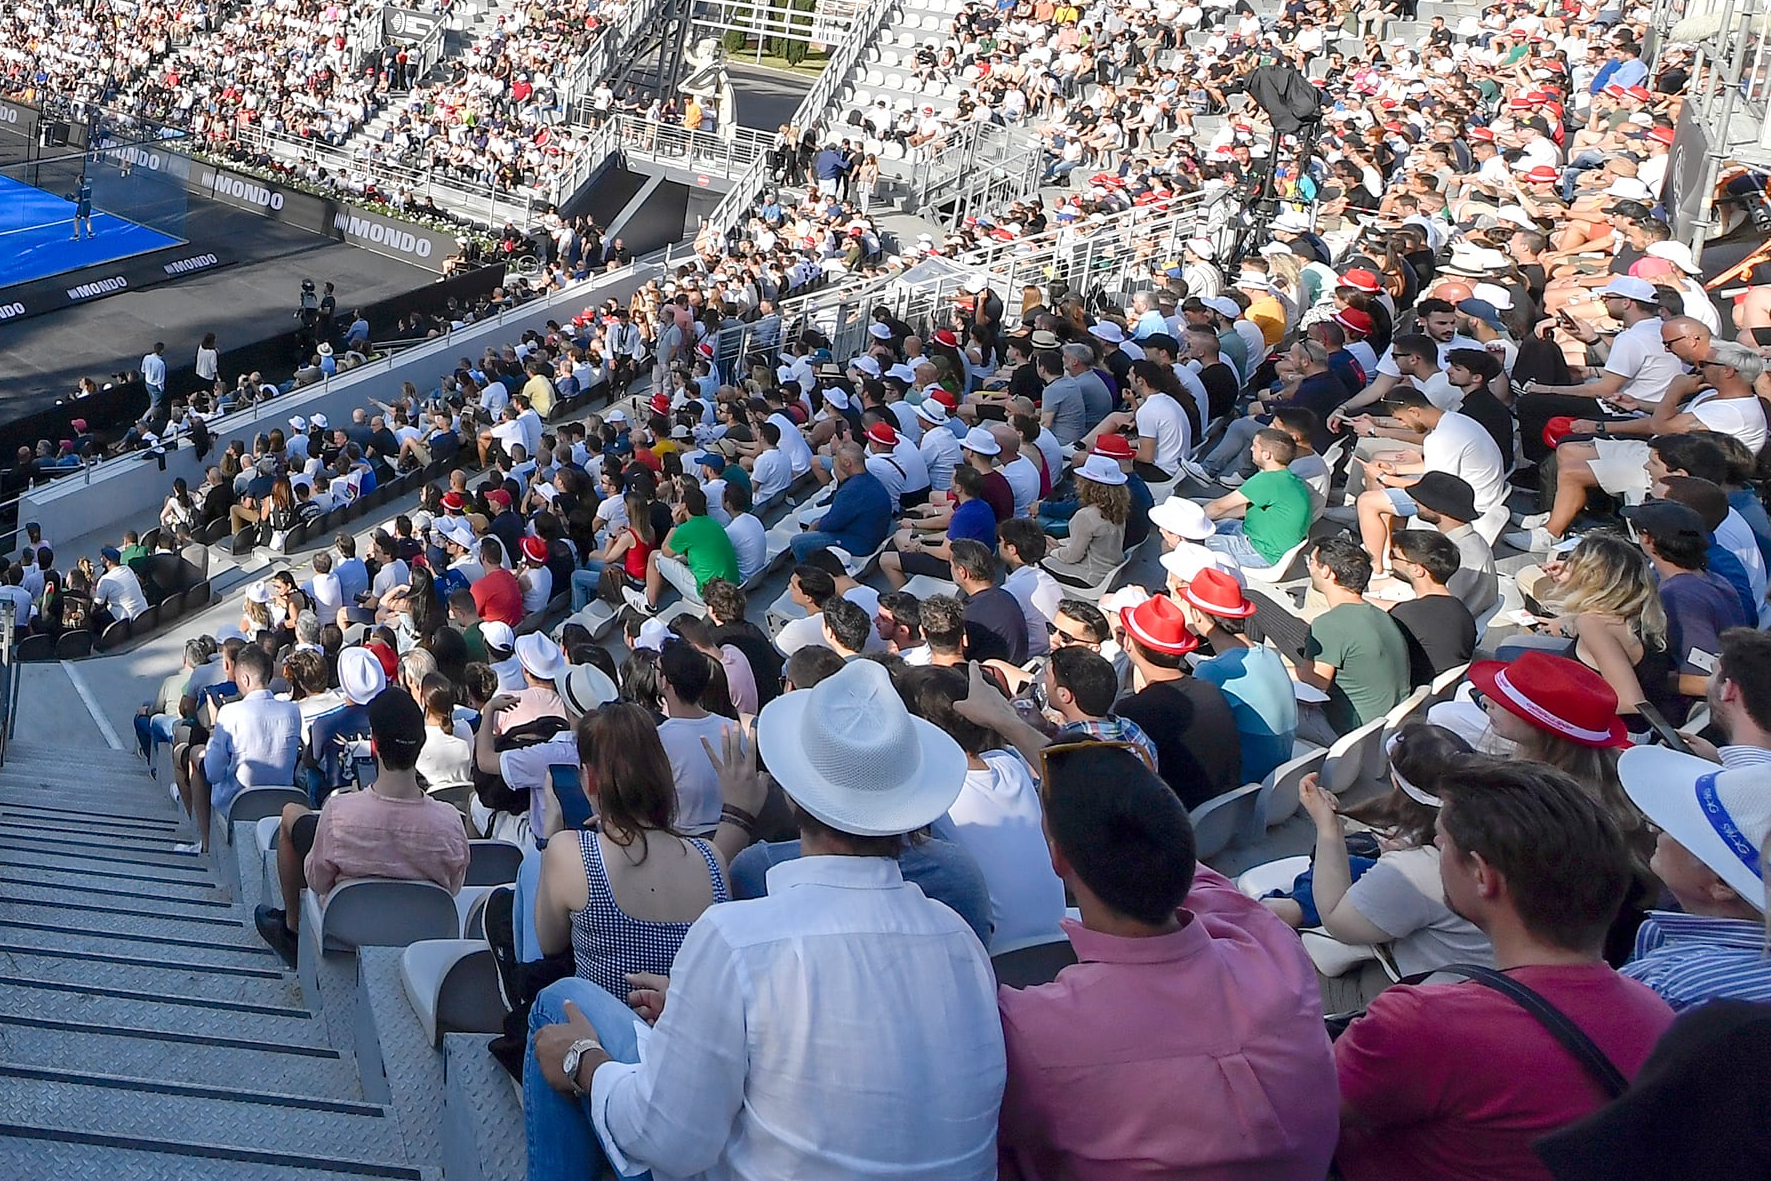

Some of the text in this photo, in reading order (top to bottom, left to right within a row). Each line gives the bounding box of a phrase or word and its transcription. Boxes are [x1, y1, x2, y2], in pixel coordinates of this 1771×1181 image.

[215, 174, 284, 211] MONDO
[349, 215, 432, 258] MONDO
[173, 253, 218, 274] MONDO
[76, 275, 128, 298] MONDO
